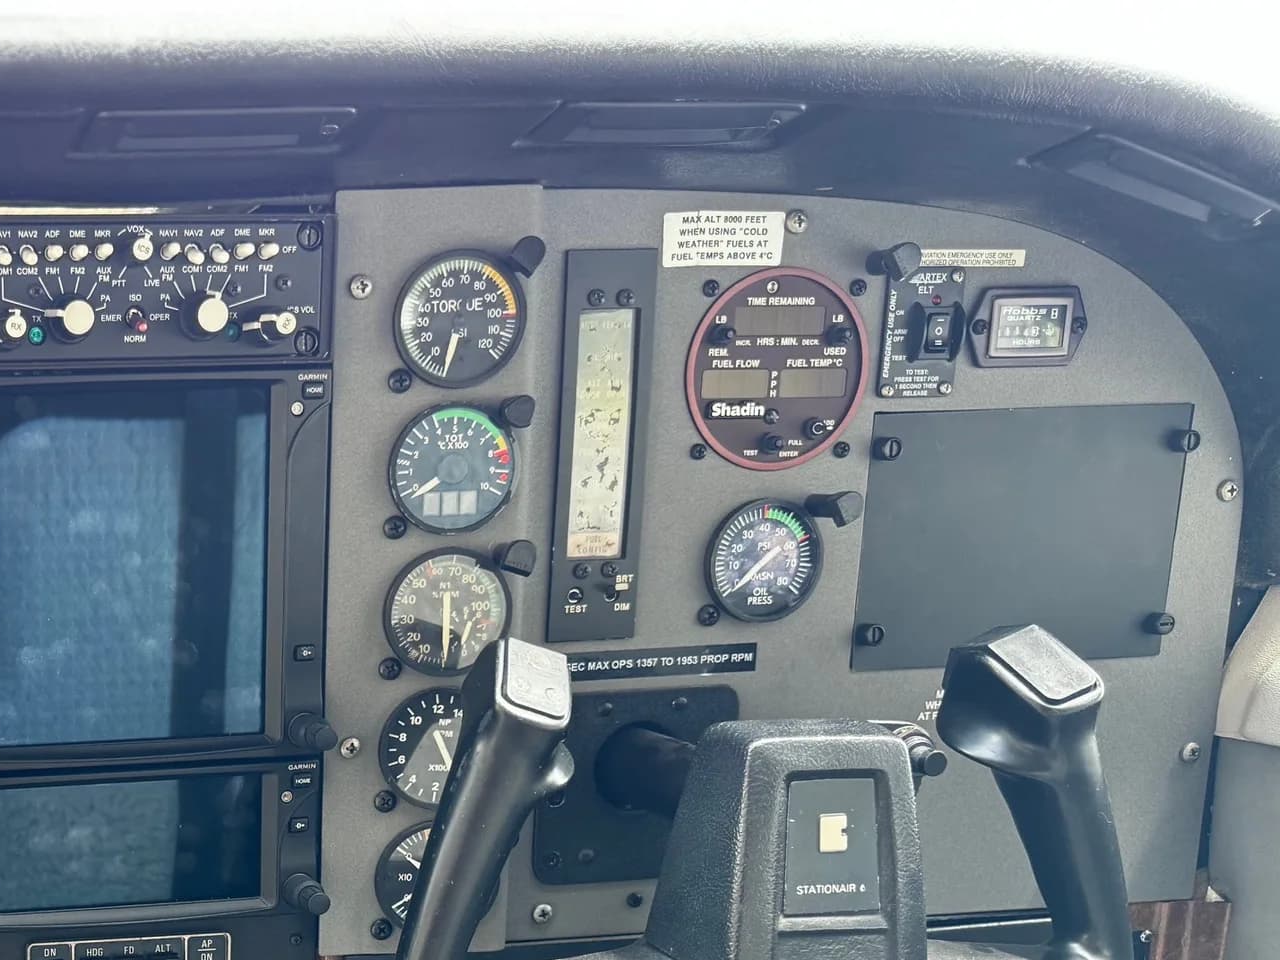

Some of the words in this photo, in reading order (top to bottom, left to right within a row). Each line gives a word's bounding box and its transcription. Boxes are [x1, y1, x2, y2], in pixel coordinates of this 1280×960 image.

[682, 216, 702, 224] MAX
[705, 216, 722, 224] ALT
[746, 216, 767, 224] FEET
[70, 230, 86, 238] DME
[679, 228, 705, 236] WHEN
[709, 227, 736, 236] USING
[727, 239, 754, 248] FUELS
[756, 240, 768, 248] AT
[671, 253, 693, 262] FUEL
[729, 251, 756, 260] ABOVE
[17, 267, 38, 275] COM2
[747, 297, 766, 305] TIME
[769, 297, 815, 305] REMAINING
[883, 331, 894, 378] EMERGENCY
[890, 289, 898, 310] ONLY
[713, 360, 734, 368] FUEL
[787, 359, 808, 367] FUEL
[712, 403, 765, 416] Shadin
[753, 588, 768, 597] OIL
[747, 596, 773, 606] PRESS
[564, 604, 587, 614] TEST
[614, 602, 630, 612] DIM
[588, 661, 609, 670] MAX
[611, 660, 633, 669] OPS
[636, 658, 657, 667] 1357
[660, 657, 673, 666] TO
[677, 656, 698, 665] 1953
[700, 655, 728, 664] PROP
[731, 653, 752, 662] RPM
[796, 883, 856, 895] STATIONAIR
[155, 944, 171, 953] ALT
[201, 940, 213, 949] AP
[86, 948, 104, 958] HDG
